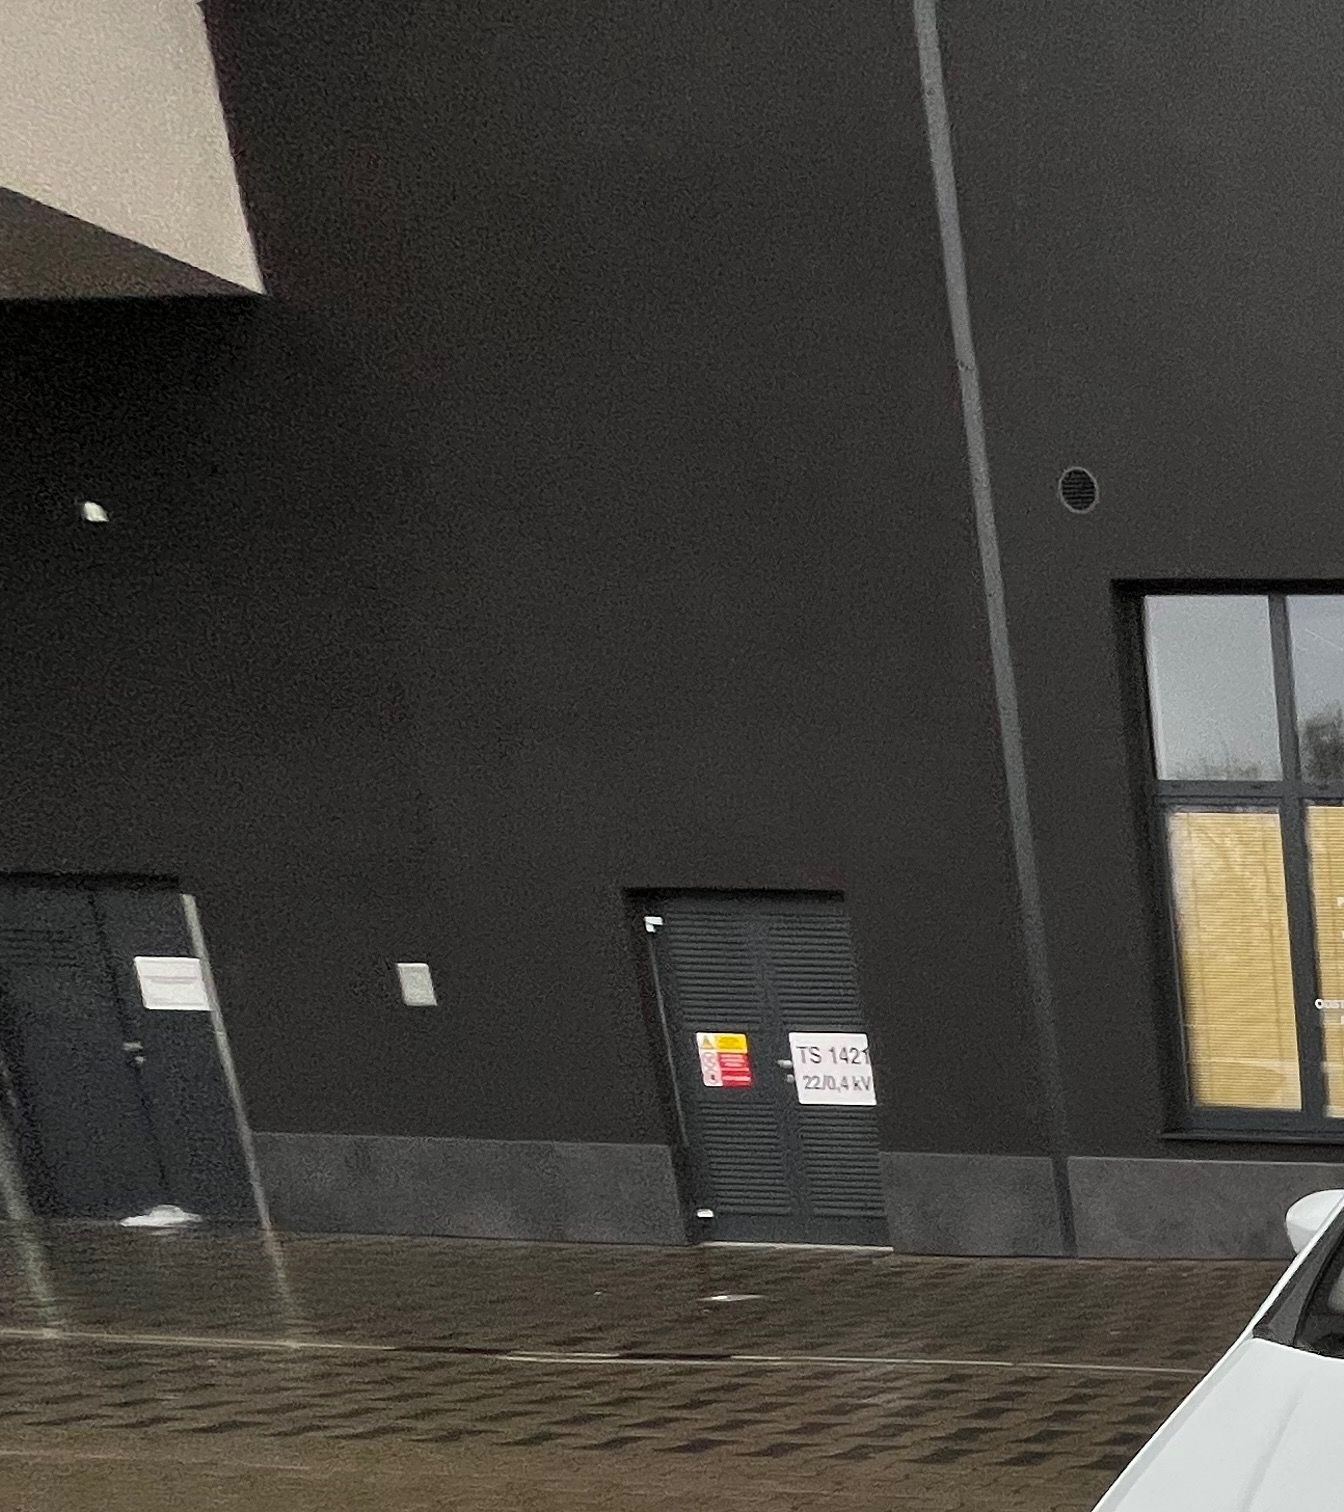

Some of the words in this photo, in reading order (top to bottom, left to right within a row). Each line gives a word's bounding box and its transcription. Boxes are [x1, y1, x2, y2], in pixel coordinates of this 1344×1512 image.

[796, 1046, 822, 1064] TS
[830, 1047, 870, 1065] 1421
[803, 1075, 850, 1092] 22/0,4
[853, 1075, 872, 1091] kV
